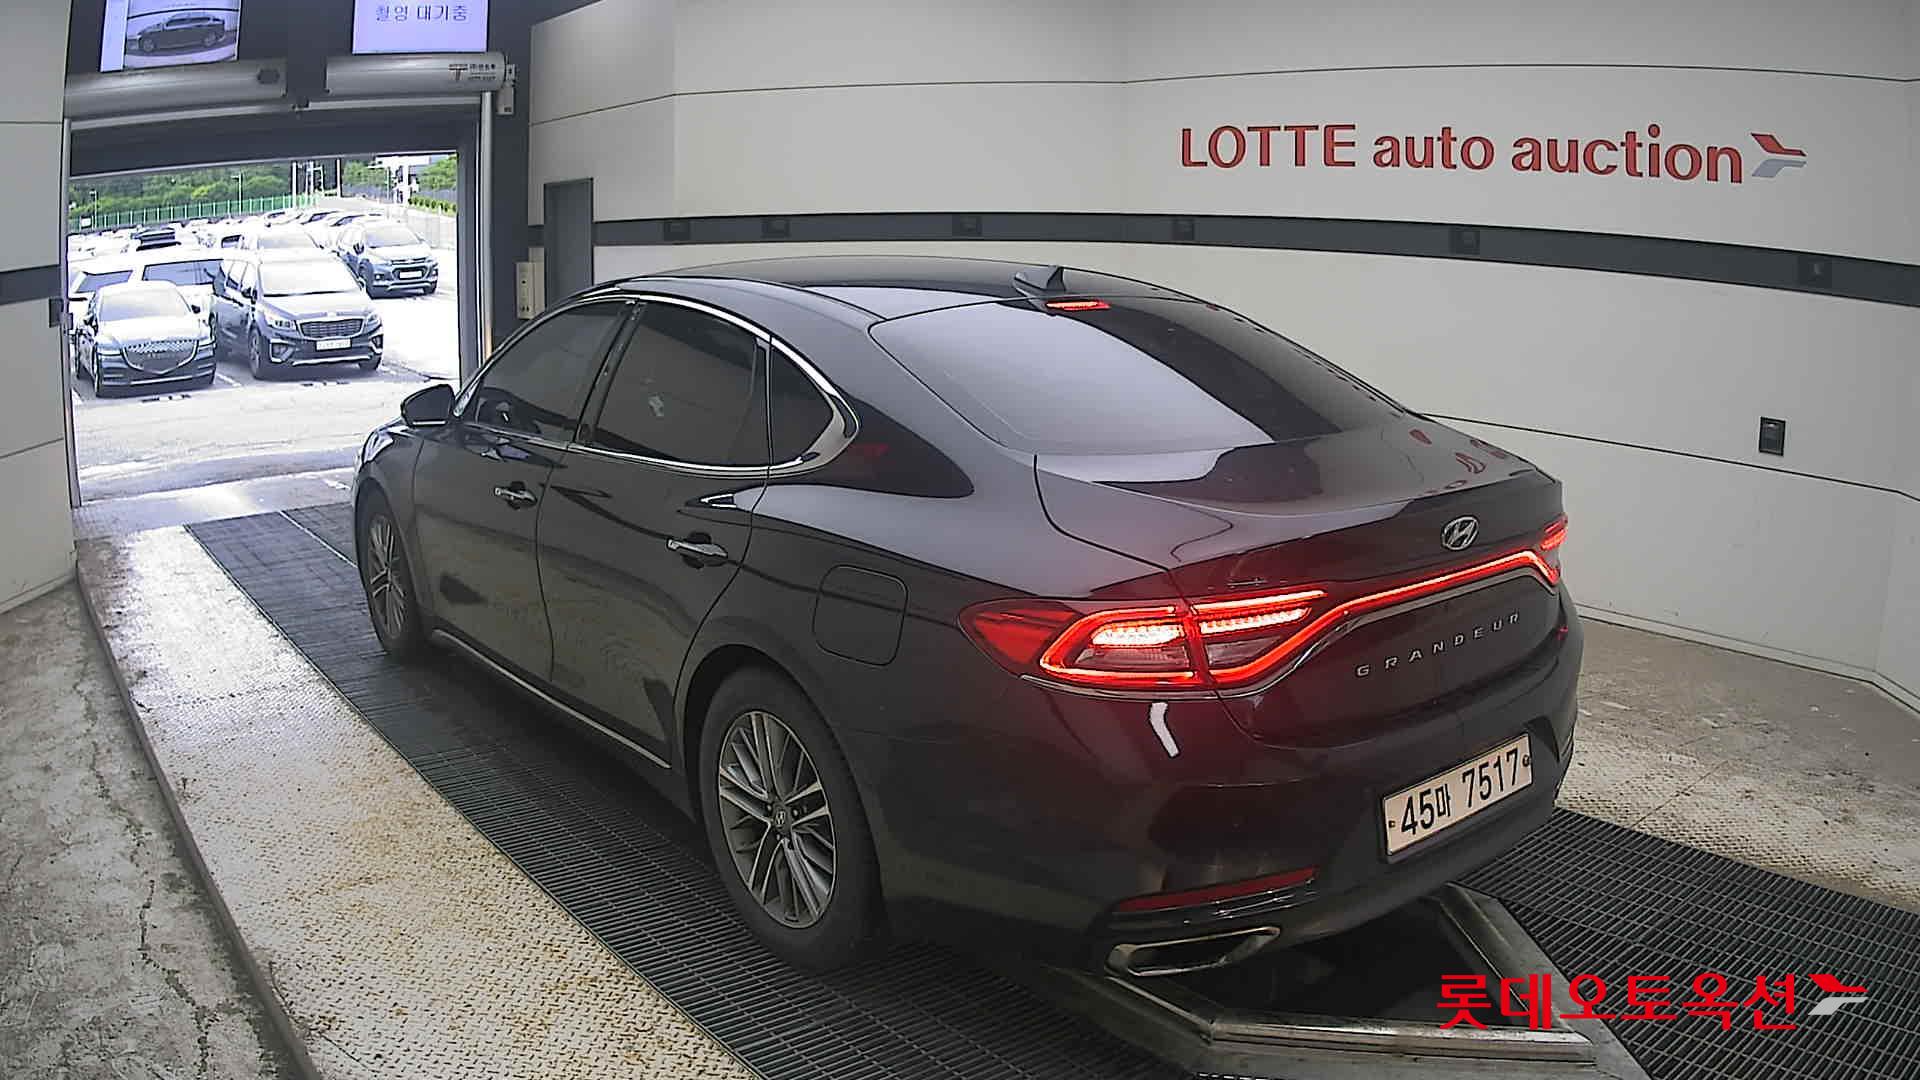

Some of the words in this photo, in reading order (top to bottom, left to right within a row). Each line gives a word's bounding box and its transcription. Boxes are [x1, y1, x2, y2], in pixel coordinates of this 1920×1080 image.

[417, 5, 467, 21] 대기중
[1181, 124, 1356, 168] LOTTE
[1372, 126, 1495, 170] auto
[1511, 123, 1744, 184] auction
[1356, 613, 1519, 677] GRANDEUR
[1401, 783, 1451, 835] 45마
[1462, 747, 1519, 809] 7517
